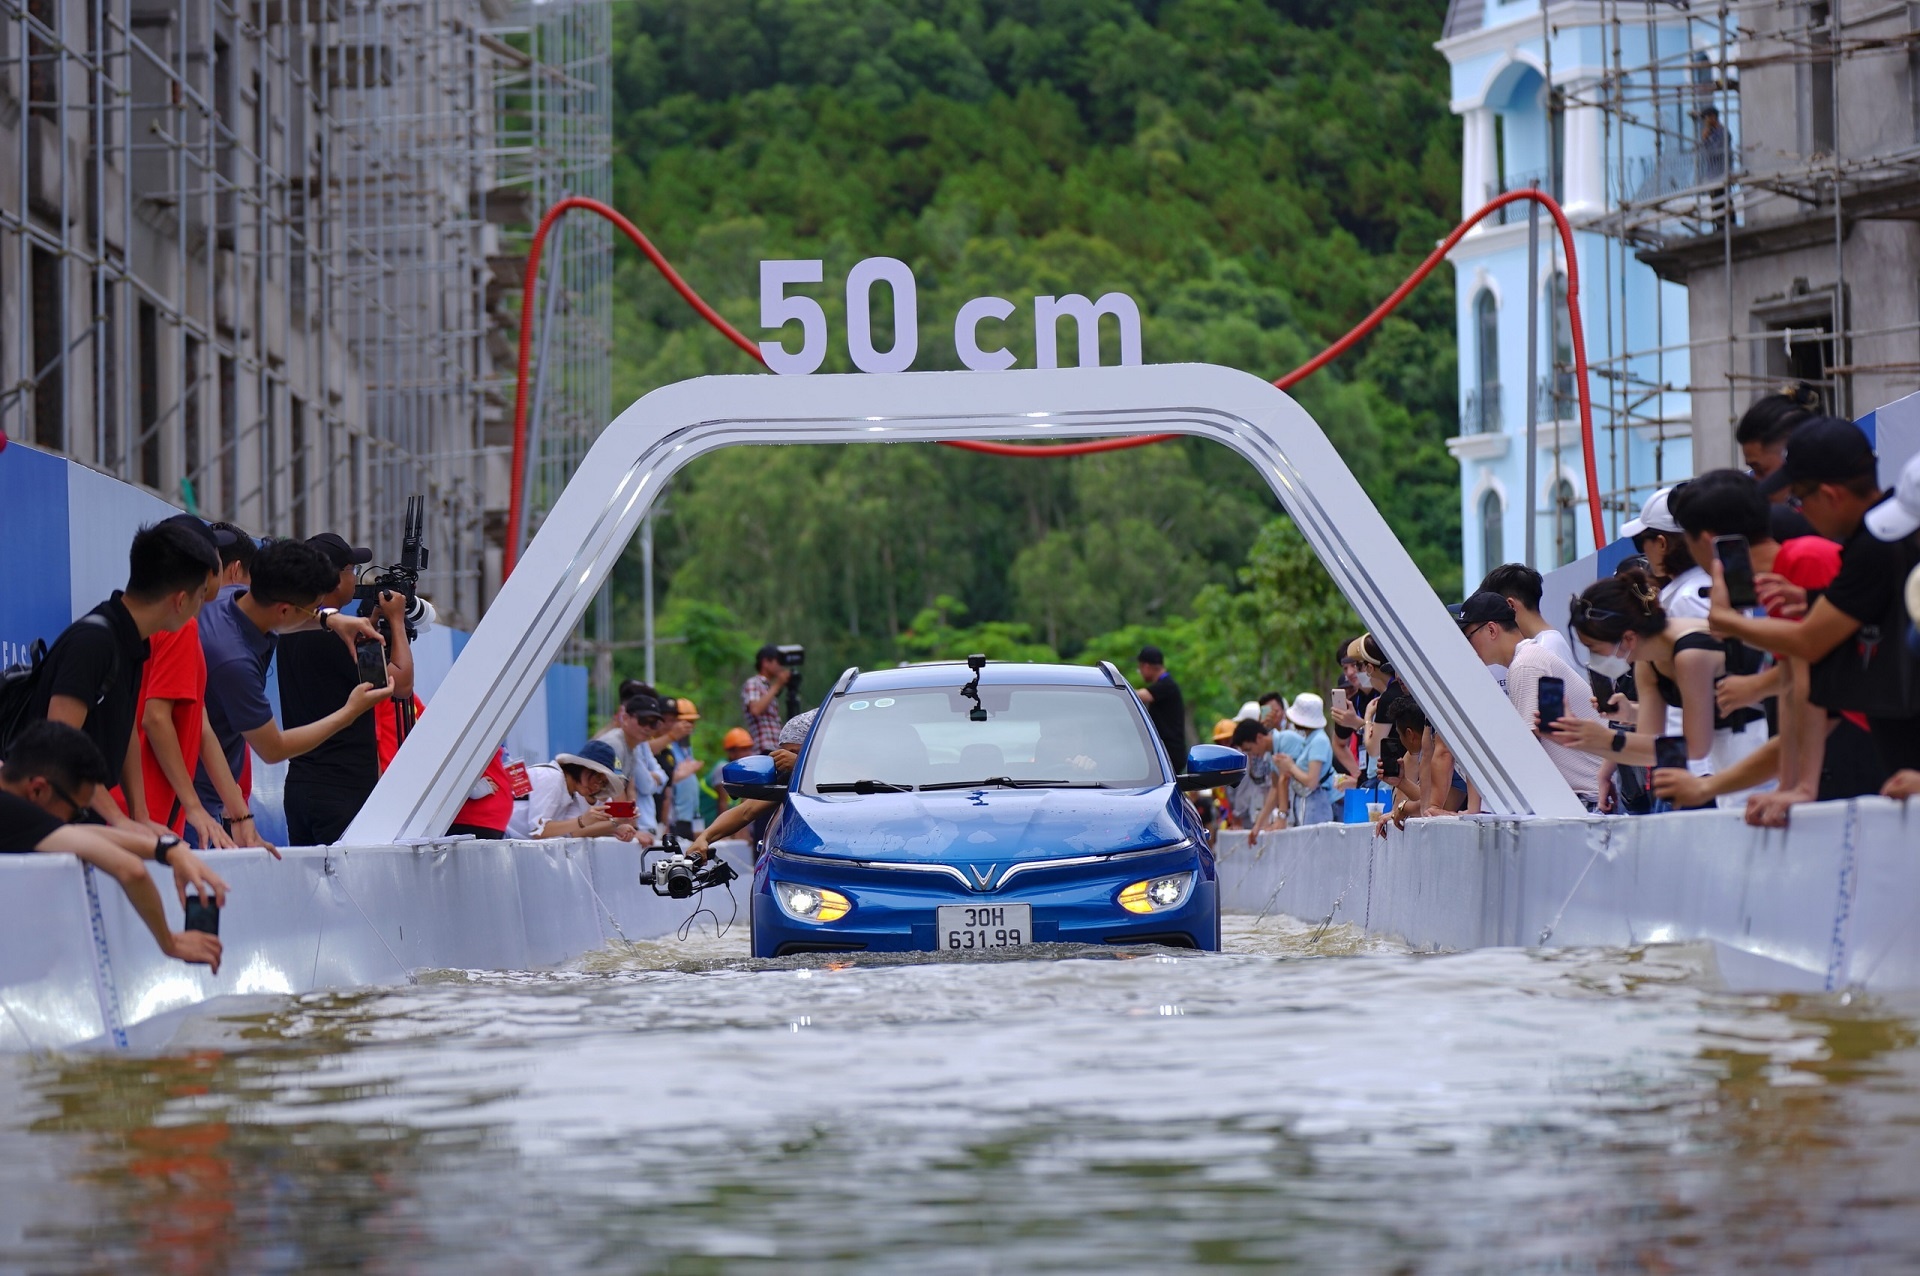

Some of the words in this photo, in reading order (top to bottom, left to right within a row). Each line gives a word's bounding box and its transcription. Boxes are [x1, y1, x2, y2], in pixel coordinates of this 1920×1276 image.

[758, 256, 918, 375] 50
[954, 291, 1143, 371] cm
[965, 908, 1004, 927] 30H
[948, 929, 1021, 949] 631.99
